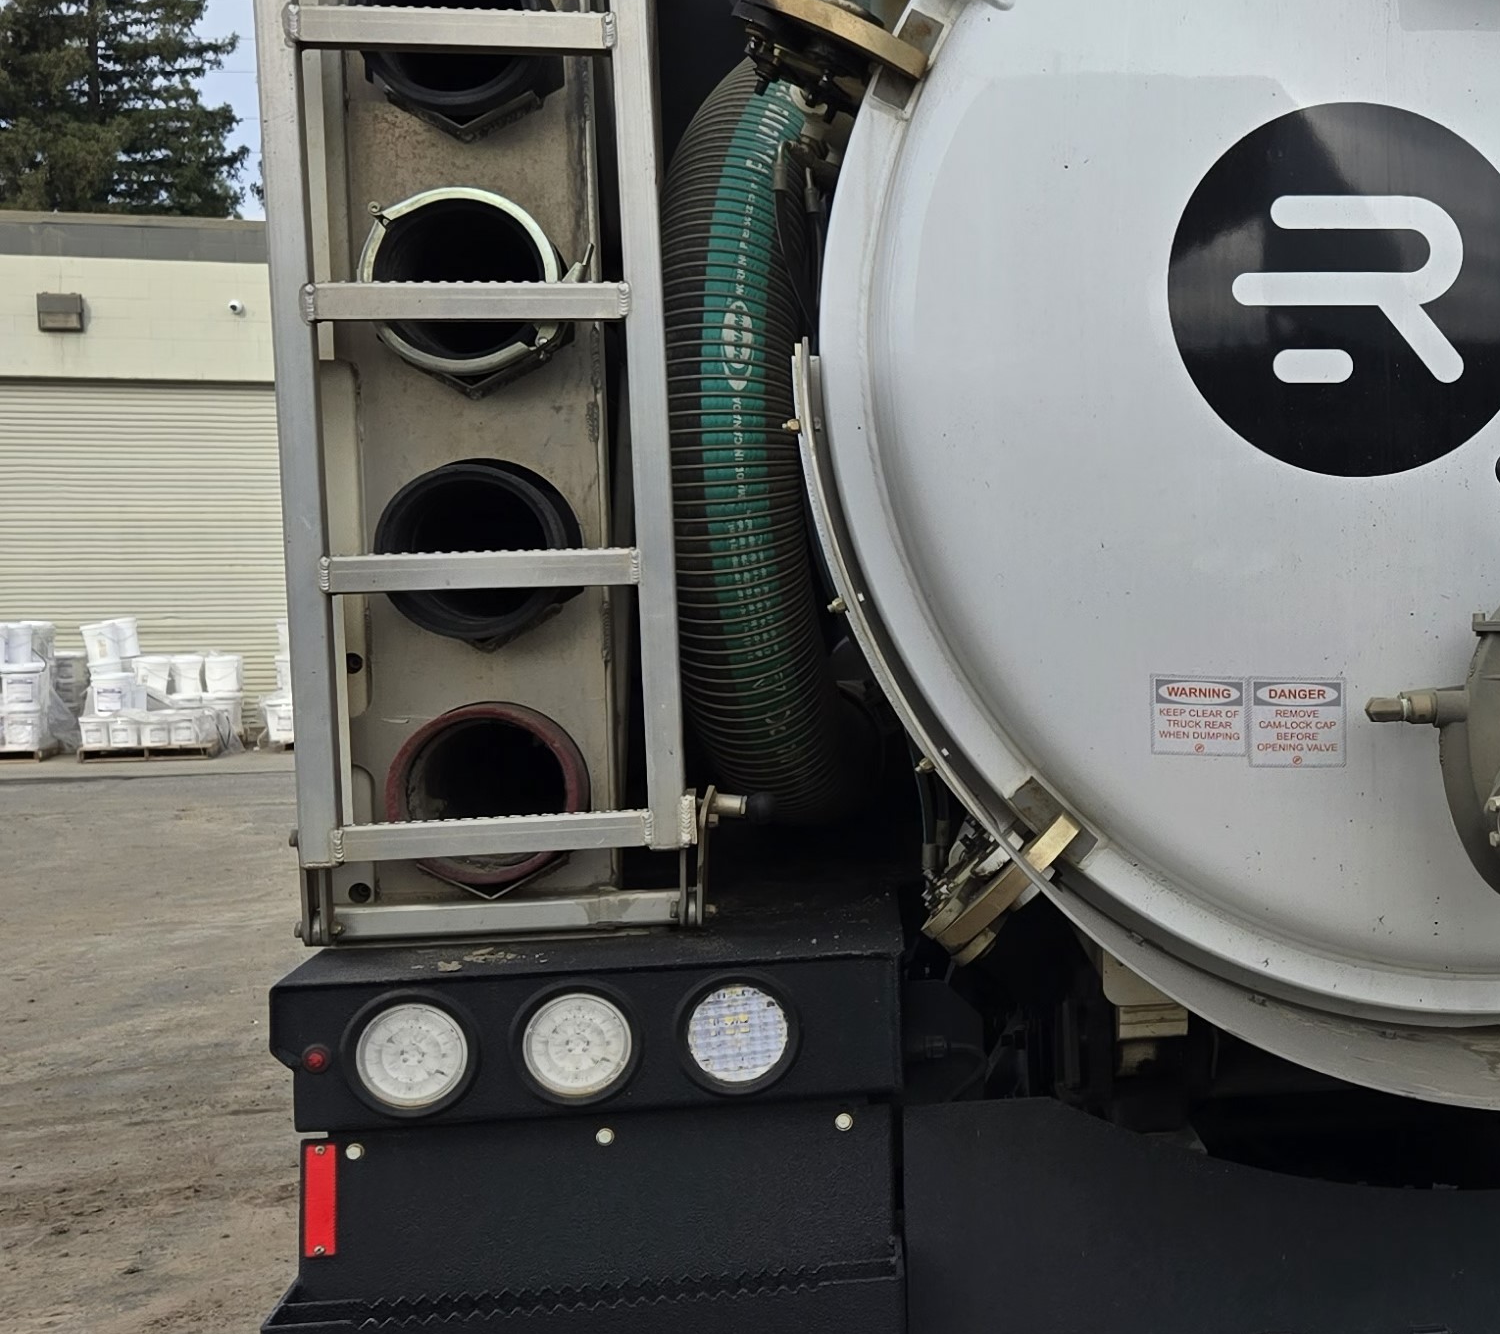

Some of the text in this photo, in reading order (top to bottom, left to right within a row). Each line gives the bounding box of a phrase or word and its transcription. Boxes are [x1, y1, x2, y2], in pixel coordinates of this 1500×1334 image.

[1166, 686, 1231, 699] WARNING
[1268, 689, 1326, 699] DANGER
[1159, 708, 1239, 718] KEEP CLEAR OF
[1275, 710, 1319, 718] REMOVE
[1167, 719, 1232, 729] TRUCK REAR
[1259, 720, 1336, 730] CAM-LOCK CAP
[1159, 730, 1240, 741] WHEN DUMPING
[1276, 732, 1318, 741] BEFORE
[1257, 743, 1338, 752] OPENING VALVE
